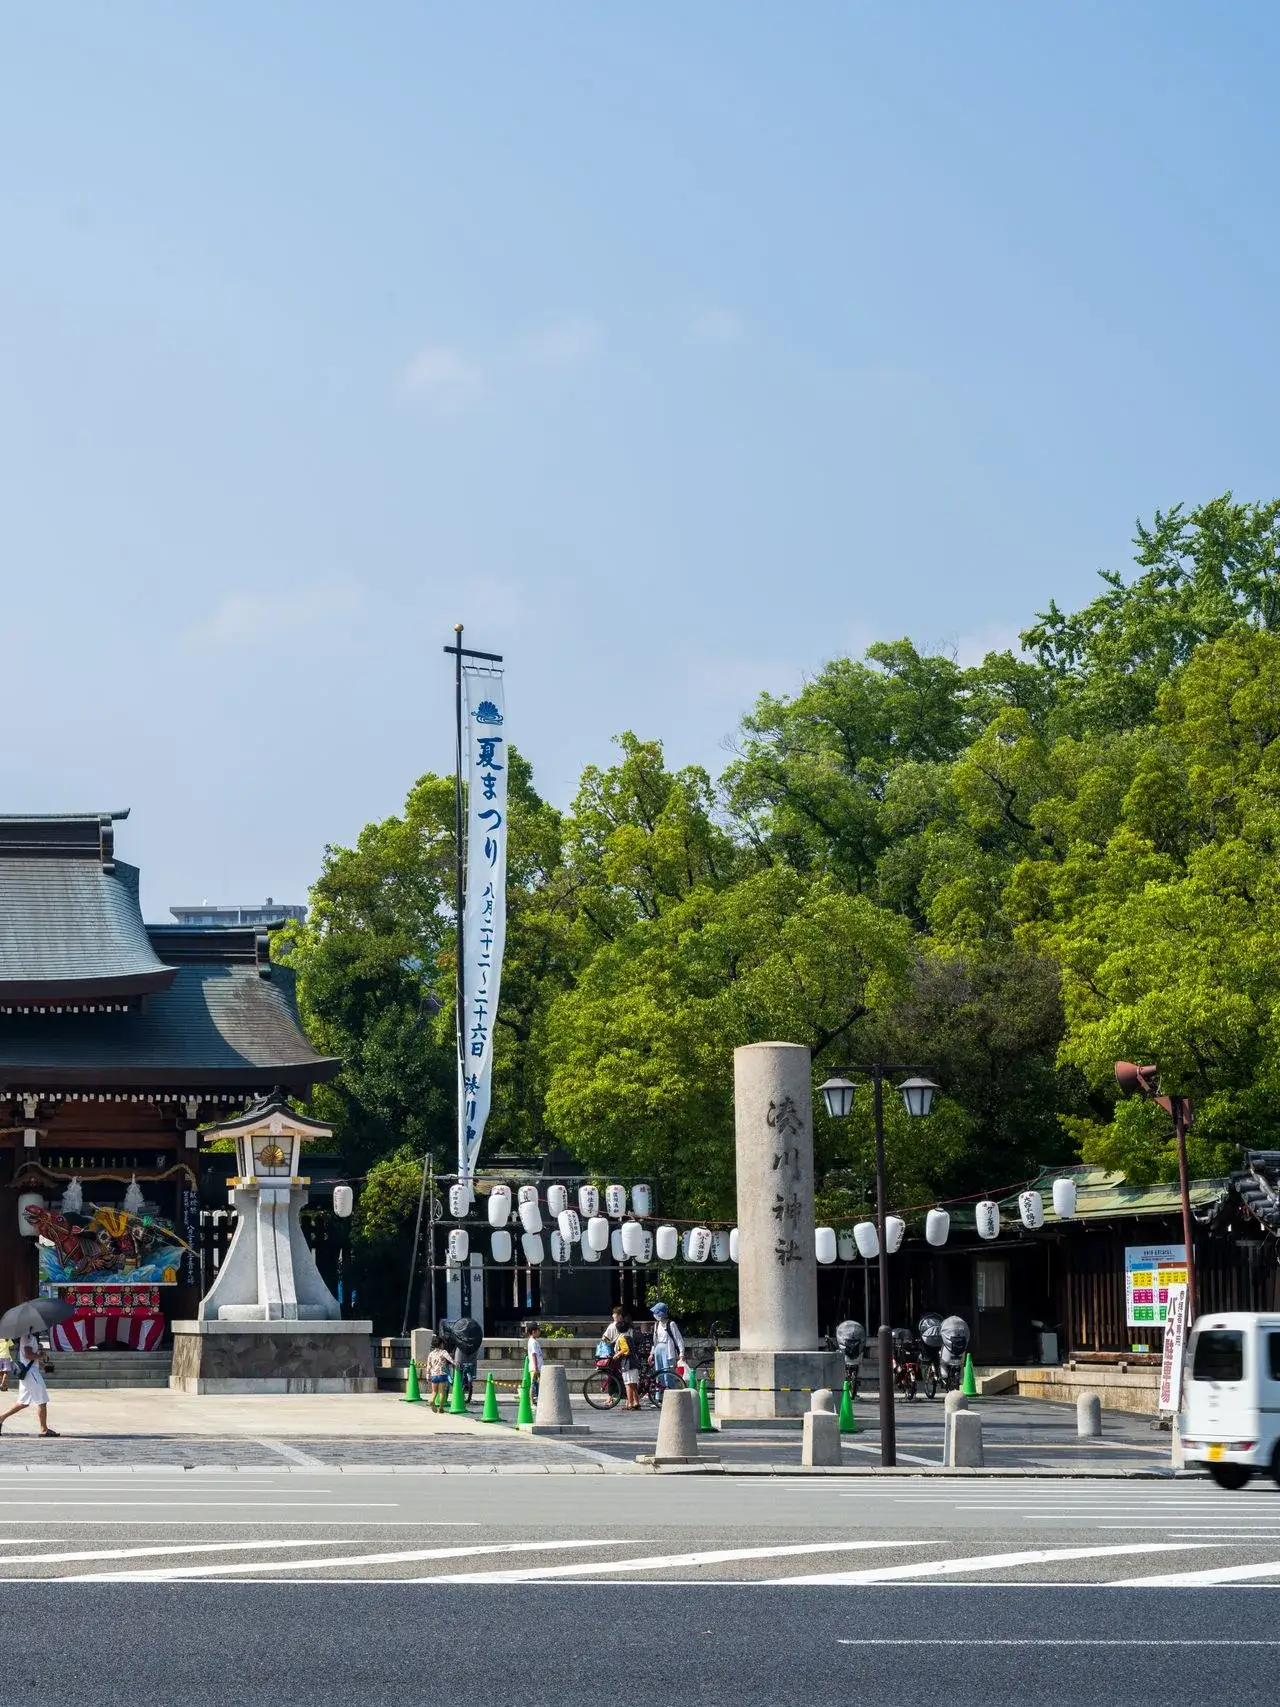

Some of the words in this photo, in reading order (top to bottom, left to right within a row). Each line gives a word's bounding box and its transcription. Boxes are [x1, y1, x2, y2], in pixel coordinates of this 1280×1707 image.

[476, 737, 504, 869] 夏まつり
[766, 1096, 803, 1266] 湊川神社
[452, 1273, 460, 1282] 奉
[472, 1273, 481, 1282] 納
[1161, 1297, 1178, 1403] バス駐車場
